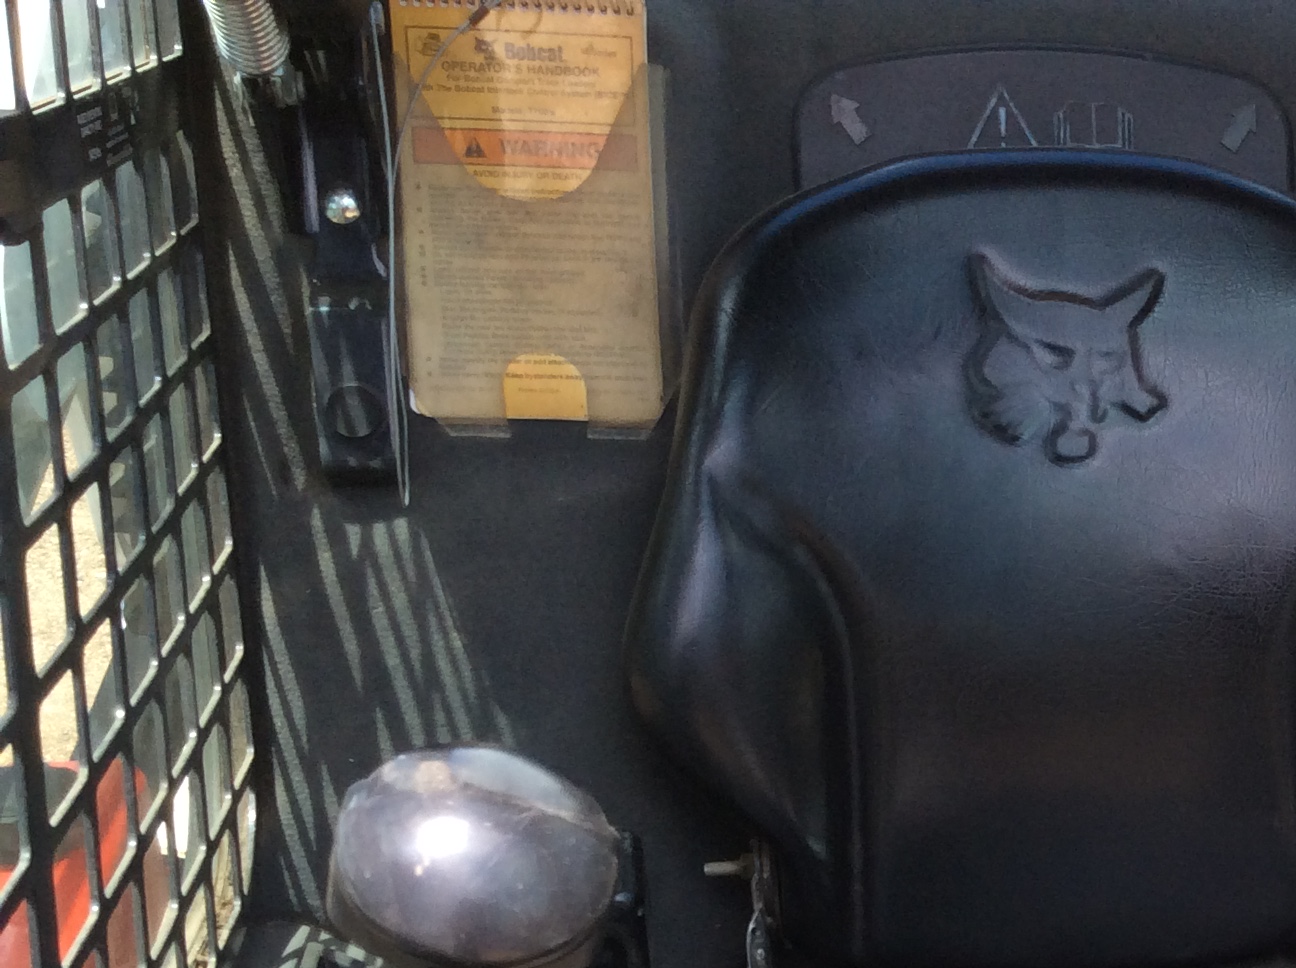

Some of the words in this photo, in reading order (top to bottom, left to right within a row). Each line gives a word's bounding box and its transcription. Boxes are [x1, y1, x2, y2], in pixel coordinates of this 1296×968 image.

[504, 42, 564, 62] Bobcat
[527, 65, 600, 77] HANDBOOK
[500, 138, 601, 157] WARNING
